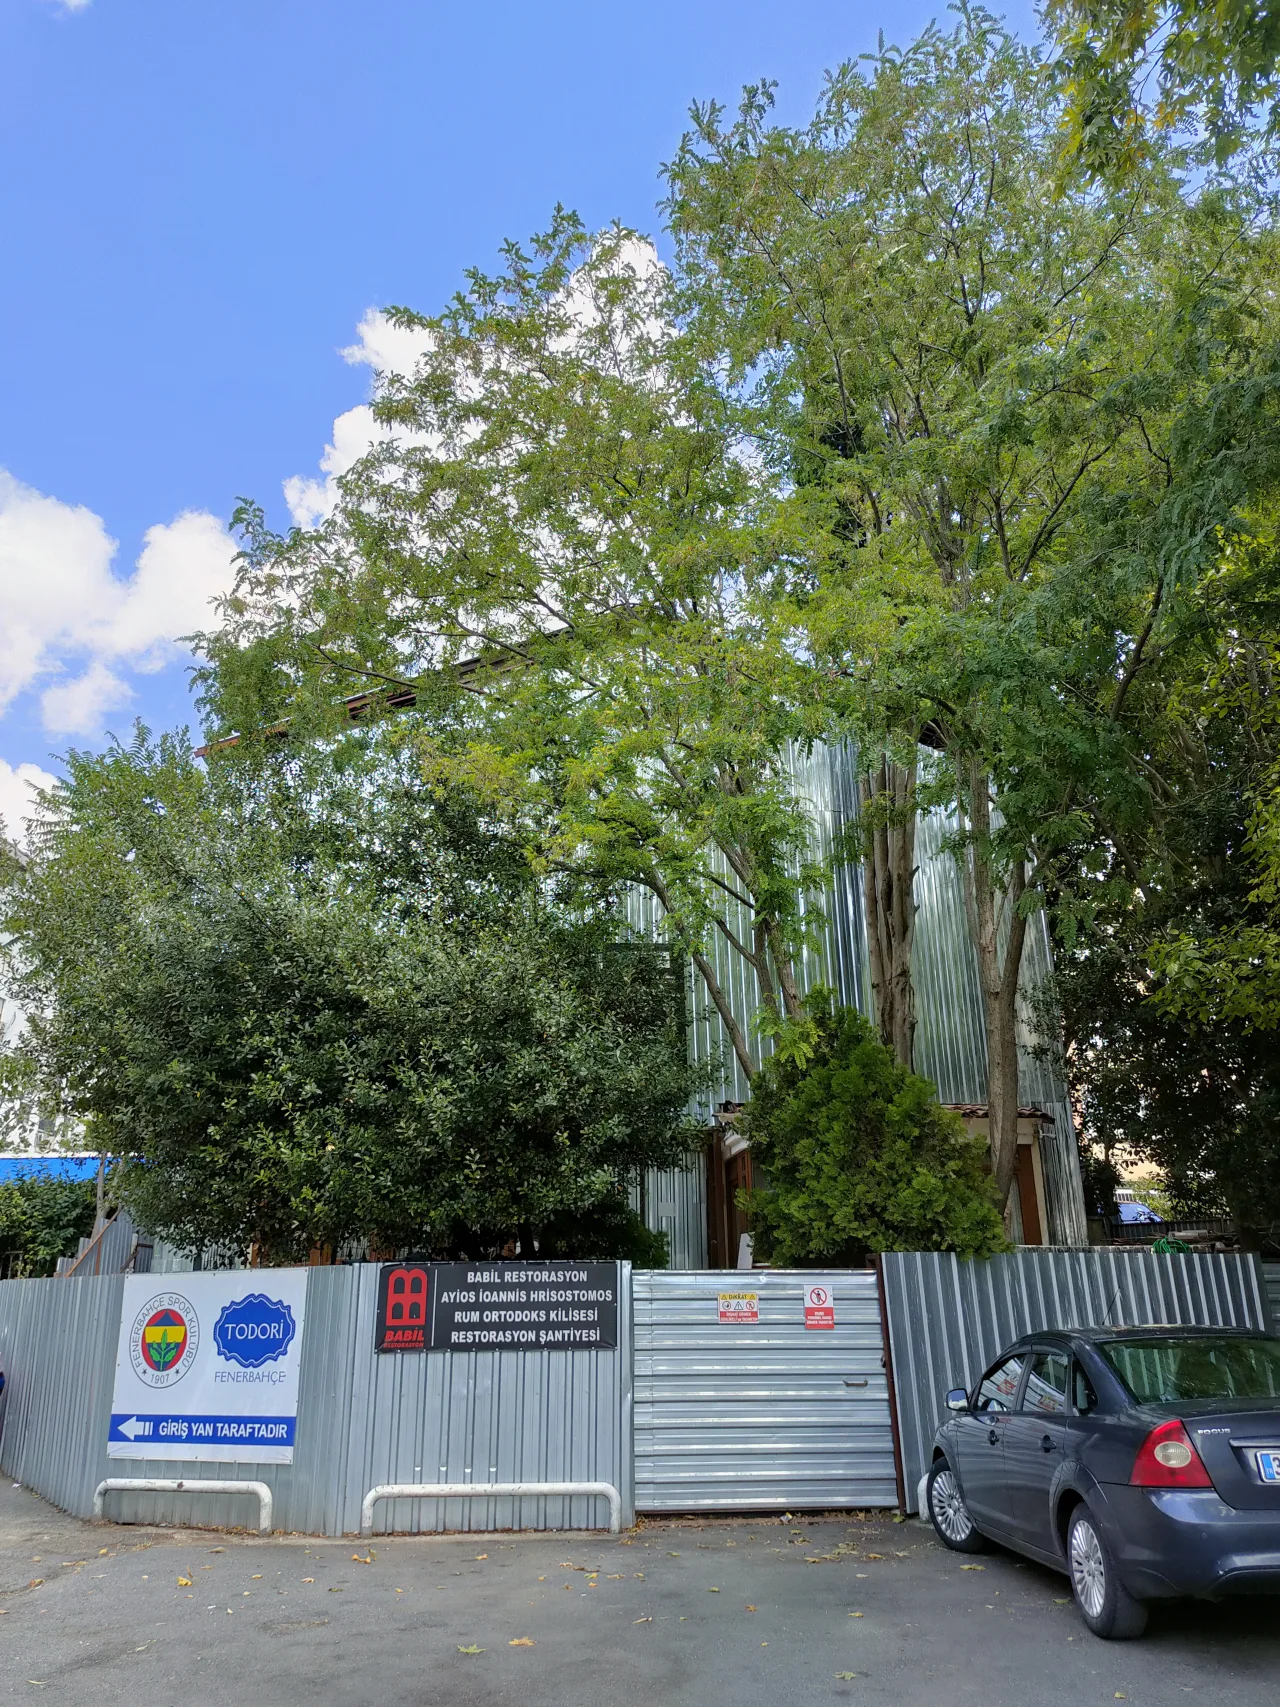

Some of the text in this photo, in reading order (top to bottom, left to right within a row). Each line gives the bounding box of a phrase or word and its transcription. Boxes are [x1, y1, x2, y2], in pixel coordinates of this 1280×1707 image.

[467, 1269, 588, 1283] BABİL RESTORASYON
[441, 1288, 613, 1303] AYİOS İOANNİS HRİSOSTOMOS
[454, 1307, 598, 1323] RUM ORTODOKS KİLİSESİ
[132, 1296, 165, 1369] FENERBAHÇE
[167, 1295, 191, 1318] SPOR
[225, 1319, 284, 1340] TODORİ
[384, 1327, 425, 1342] BABİL
[451, 1327, 600, 1344] RESTORASYON ŞANTİYESİ
[150, 1373, 170, 1385] 1907
[214, 1371, 286, 1385] FENERBAHÇE
[159, 1419, 288, 1439] GİRİŞ YAN TARAFTADIR
